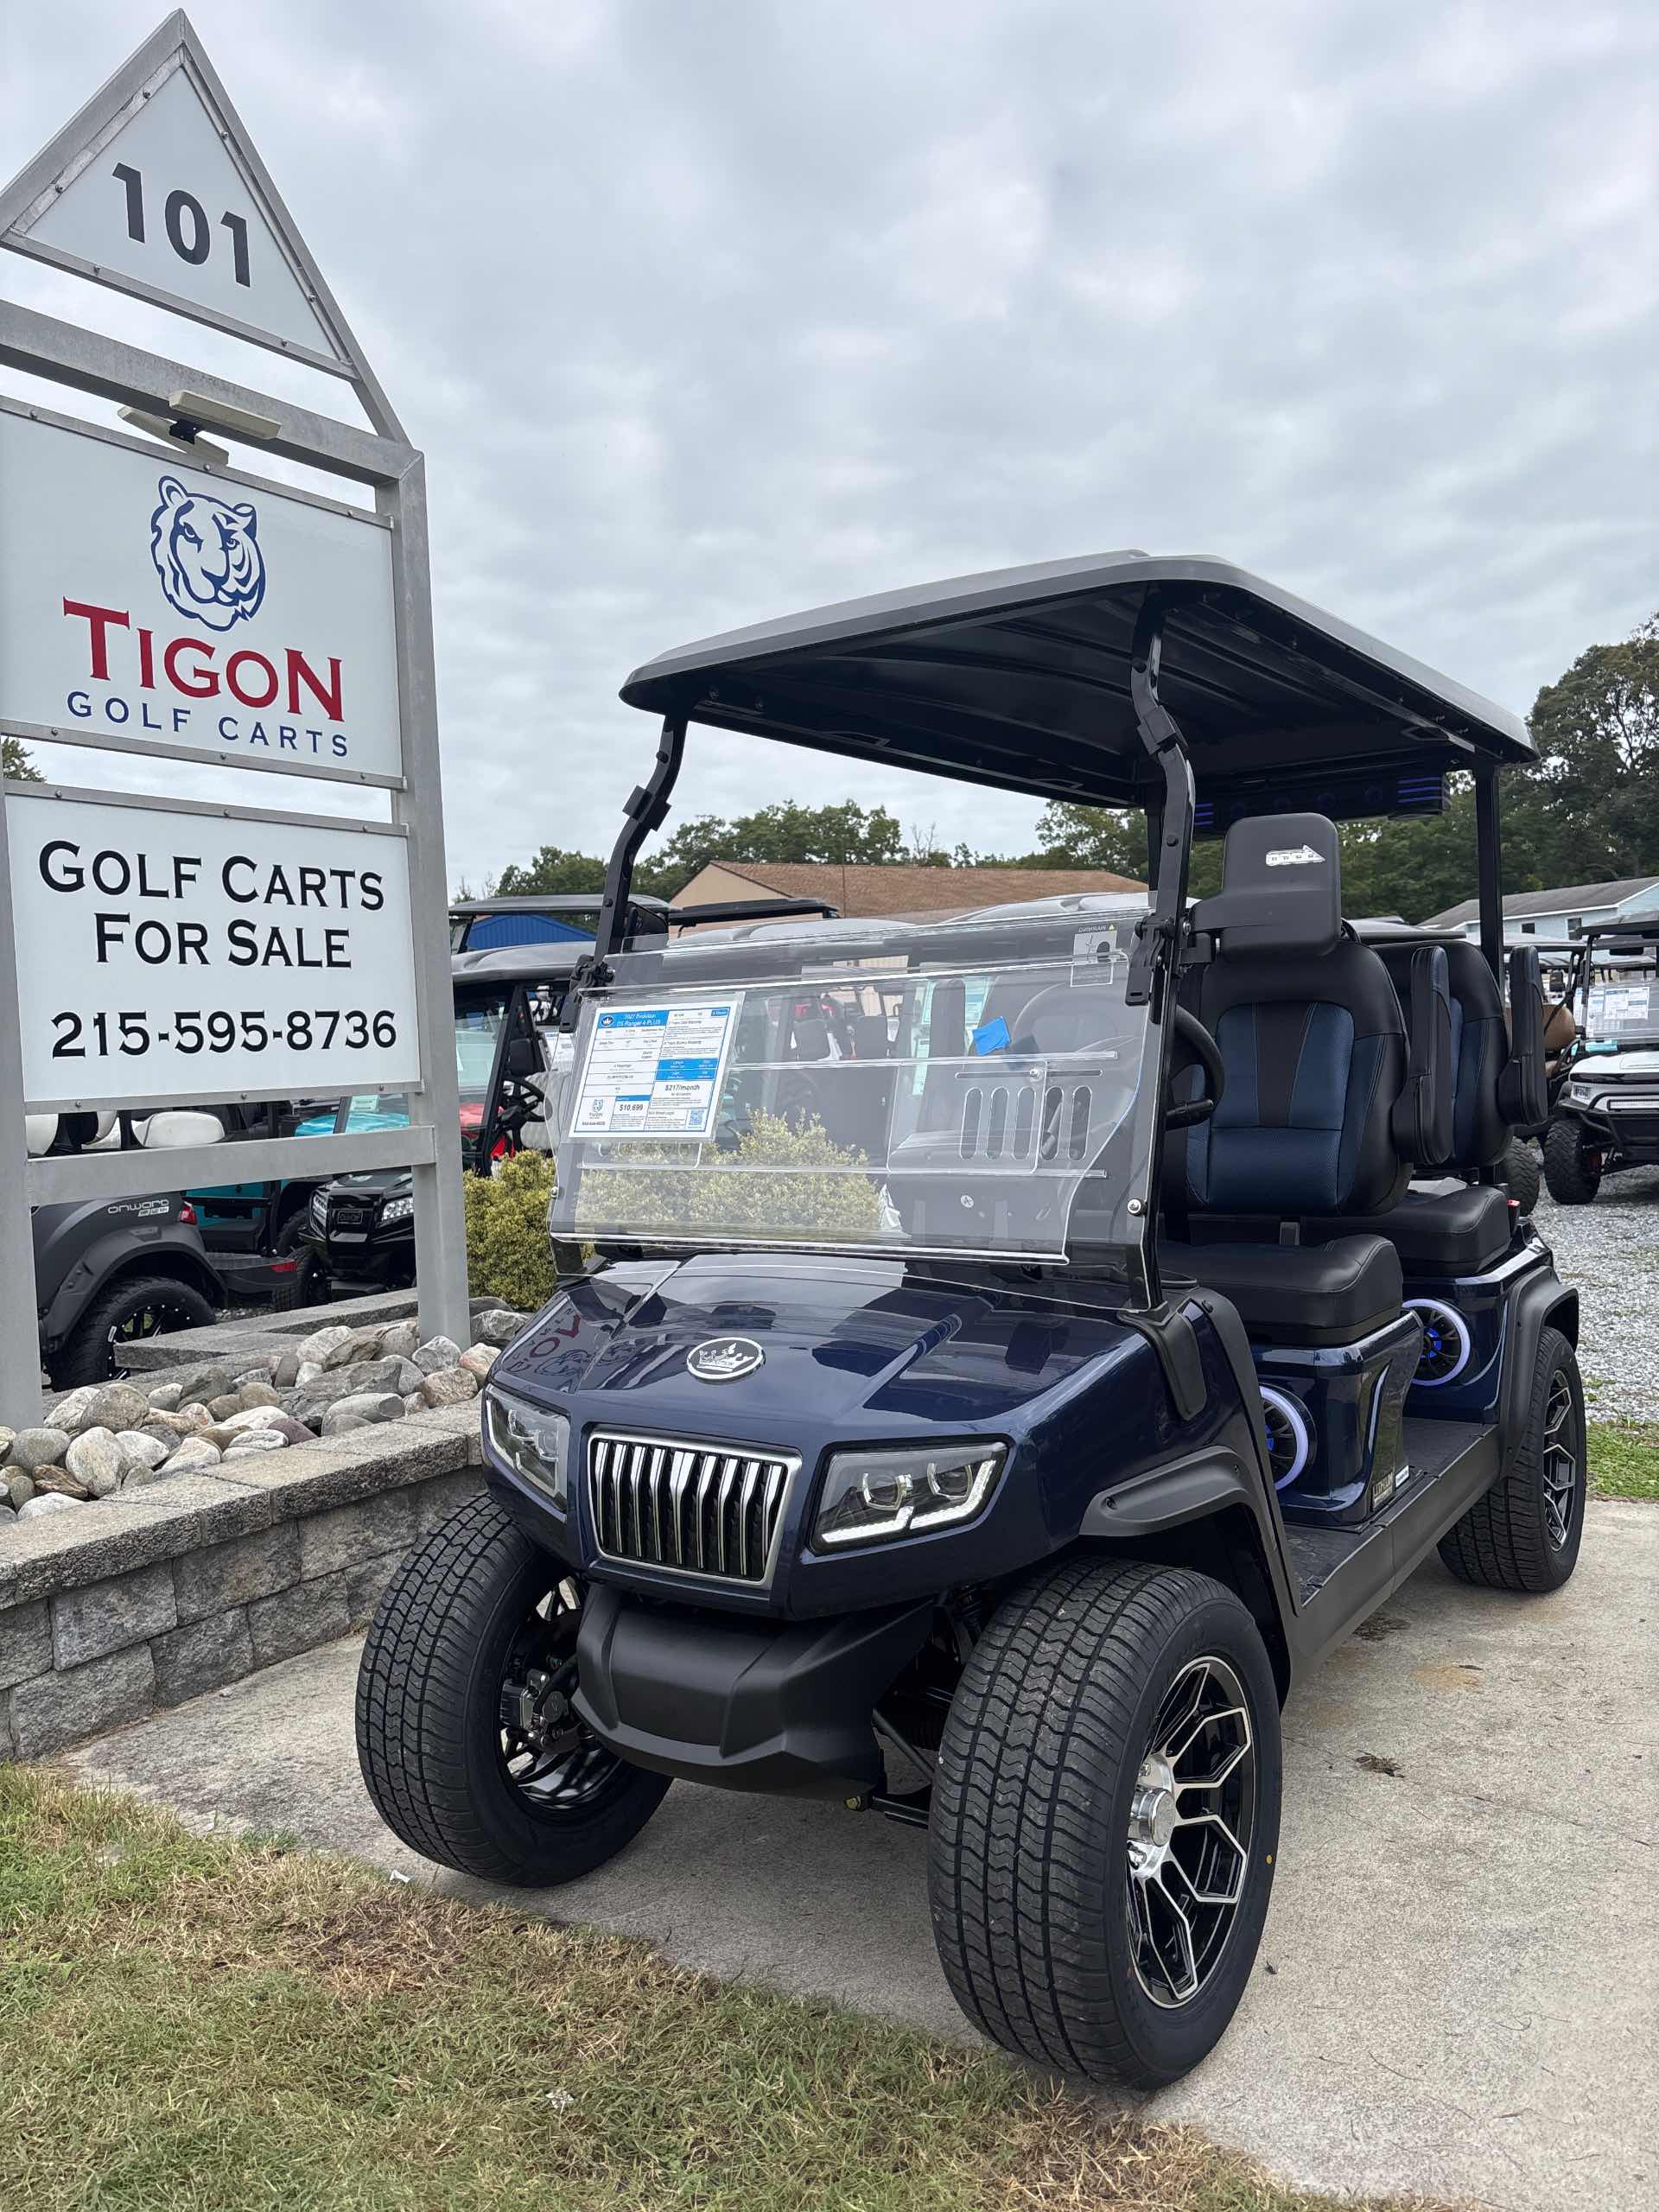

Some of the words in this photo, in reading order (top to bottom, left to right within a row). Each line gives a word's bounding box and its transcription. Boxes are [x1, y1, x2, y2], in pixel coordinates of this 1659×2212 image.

[112, 162, 251, 288] 101
[62, 596, 345, 722] TIGON
[67, 690, 192, 733] GOLF
[218, 716, 347, 757] CARTS
[39, 840, 202, 899] GOLF
[221, 855, 385, 911] CARTS
[94, 912, 210, 965] FOR
[227, 918, 352, 969] SALE
[51, 1009, 397, 1059] 215-595-8736
